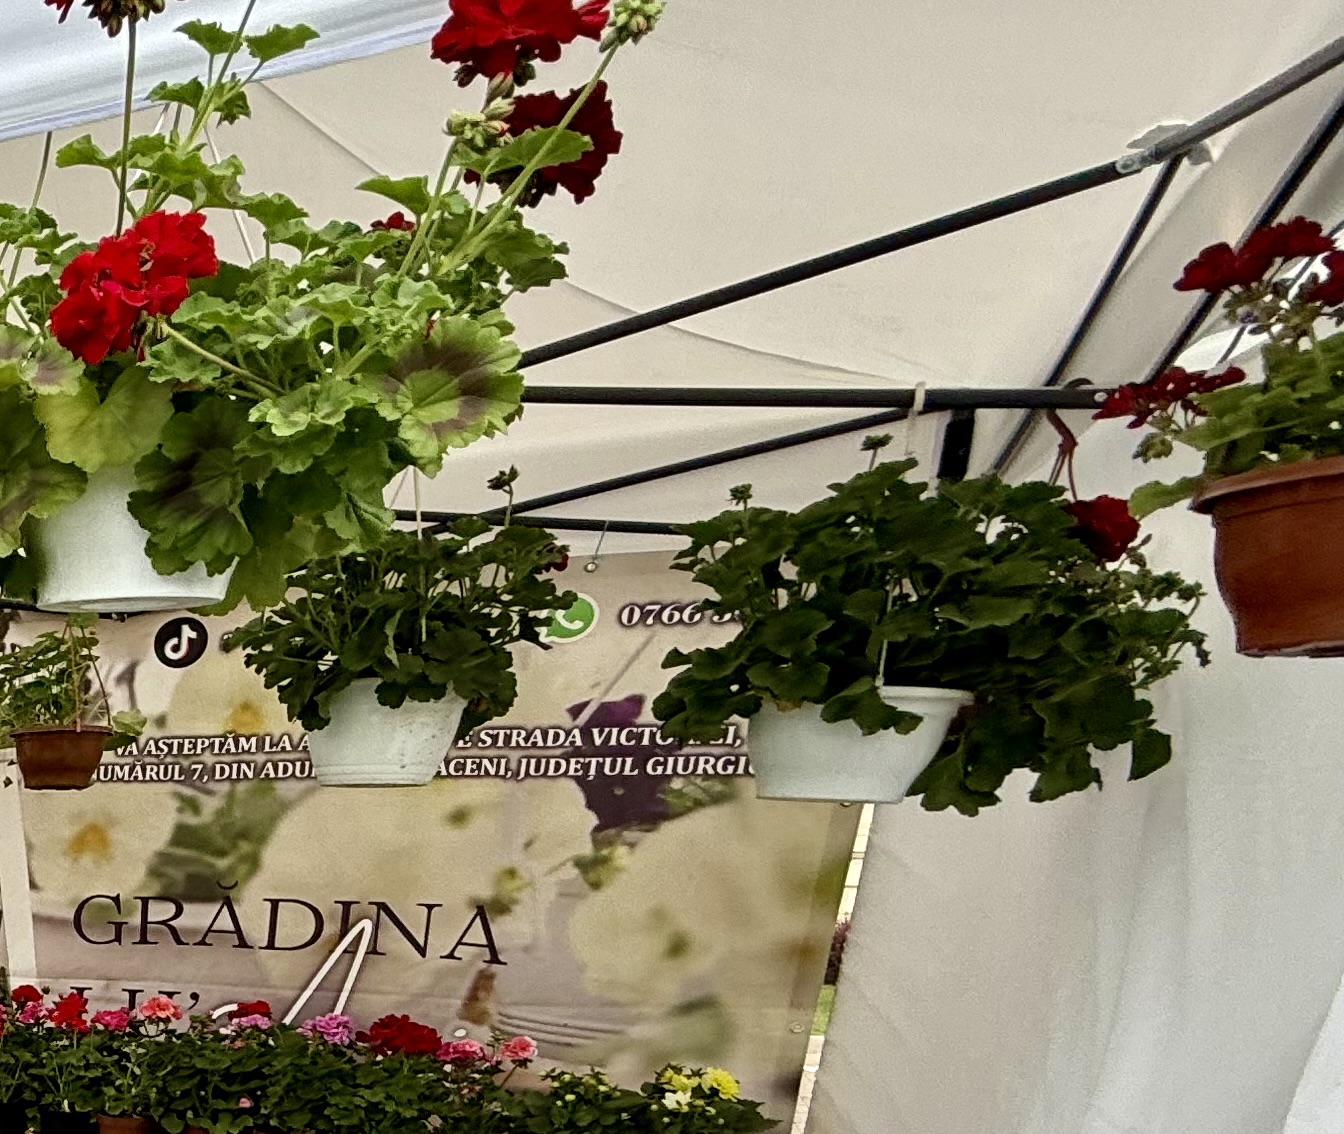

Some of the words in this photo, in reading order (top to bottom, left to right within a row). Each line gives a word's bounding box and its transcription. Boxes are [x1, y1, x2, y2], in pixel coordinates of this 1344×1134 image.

[143, 733, 257, 759] AȘTEPTĂM
[264, 735, 293, 752] LA
[478, 727, 583, 747] STRADA
[191, 764, 209, 784] 7,
[215, 762, 255, 781] DIN
[517, 757, 639, 781] JUDEȚUL
[72, 880, 509, 967] GRĂDINA
